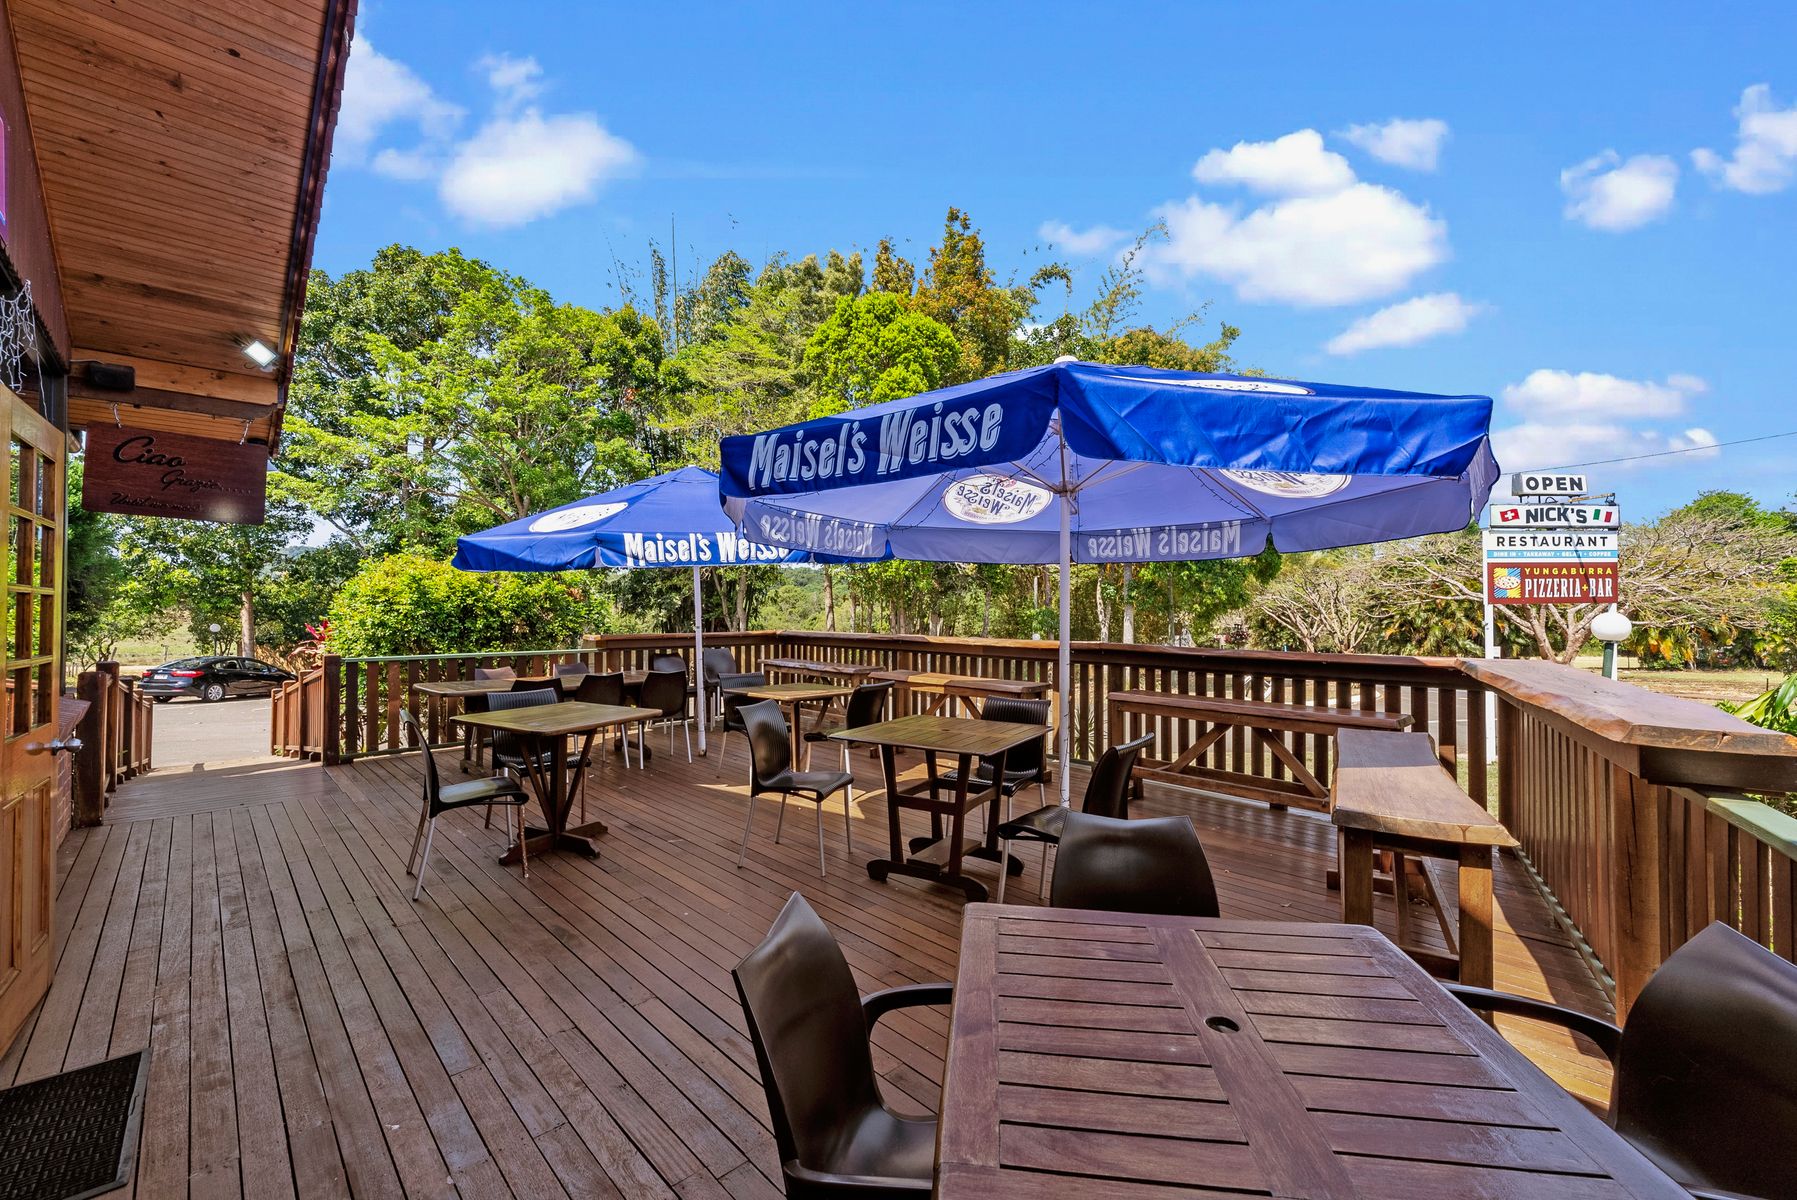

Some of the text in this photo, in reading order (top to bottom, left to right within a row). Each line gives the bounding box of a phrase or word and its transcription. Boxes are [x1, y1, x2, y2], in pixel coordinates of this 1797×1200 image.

[112, 435, 186, 467] Ciao
[748, 402, 1003, 490] Maisel's Weisse
[1525, 476, 1584, 491] OPEN
[1525, 506, 1587, 524] NICK'S
[623, 532, 712, 566] Maisel's
[1496, 536, 1608, 547] RESTAURANT
[1524, 567, 1612, 575] YUNGABURRA
[1525, 578, 1581, 598] PIZZERIA
[1589, 577, 1613, 598] BAR
